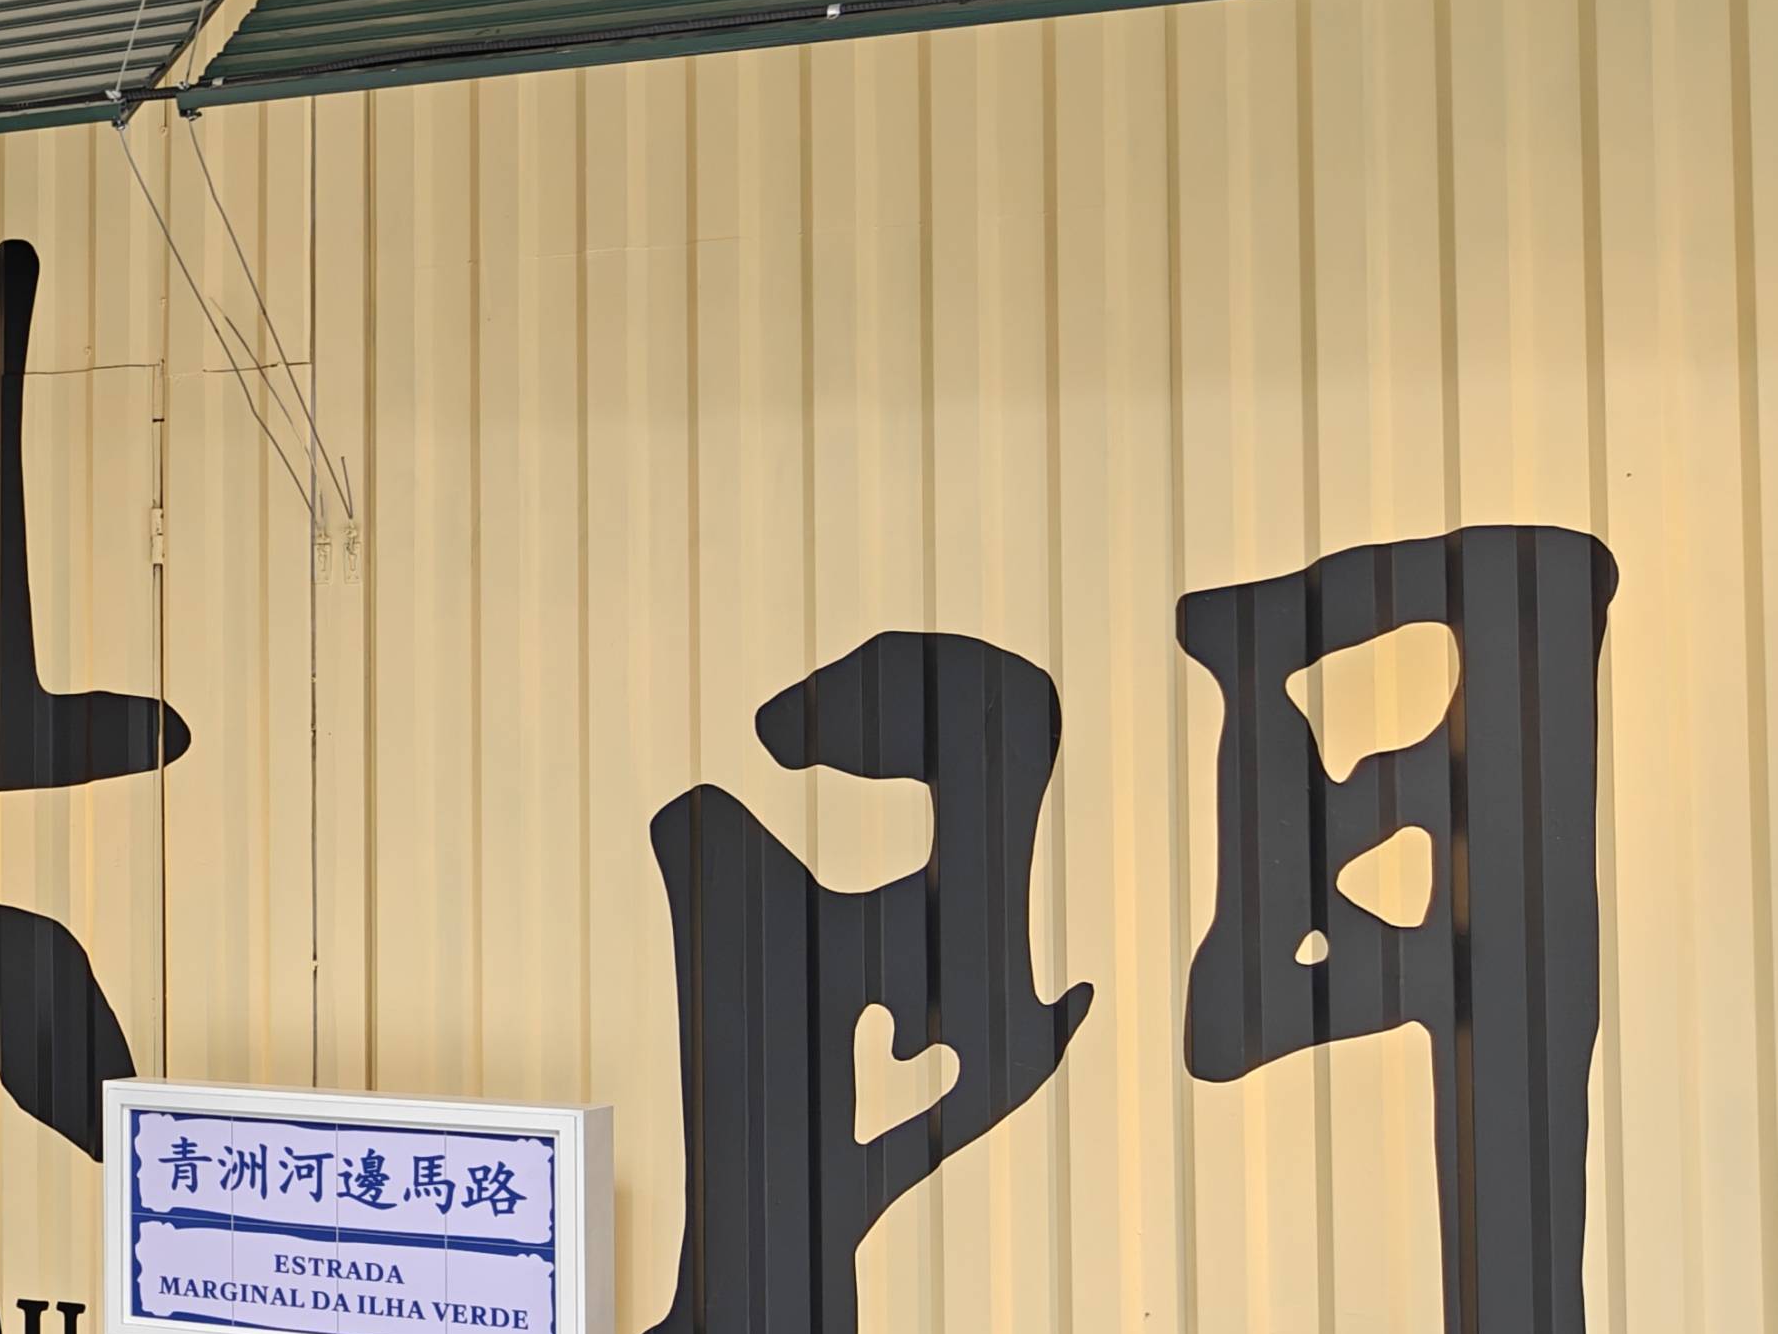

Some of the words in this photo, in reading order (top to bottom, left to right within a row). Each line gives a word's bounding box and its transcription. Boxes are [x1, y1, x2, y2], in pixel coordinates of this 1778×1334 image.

[158, 1135, 528, 1219] 青洲河邊馬路
[274, 1253, 405, 1285] ESTRADA
[158, 1275, 306, 1310] MARGINAL
[311, 1285, 351, 1313] DA
[356, 1288, 426, 1320] ILHA
[433, 1300, 530, 1331] VERDE
